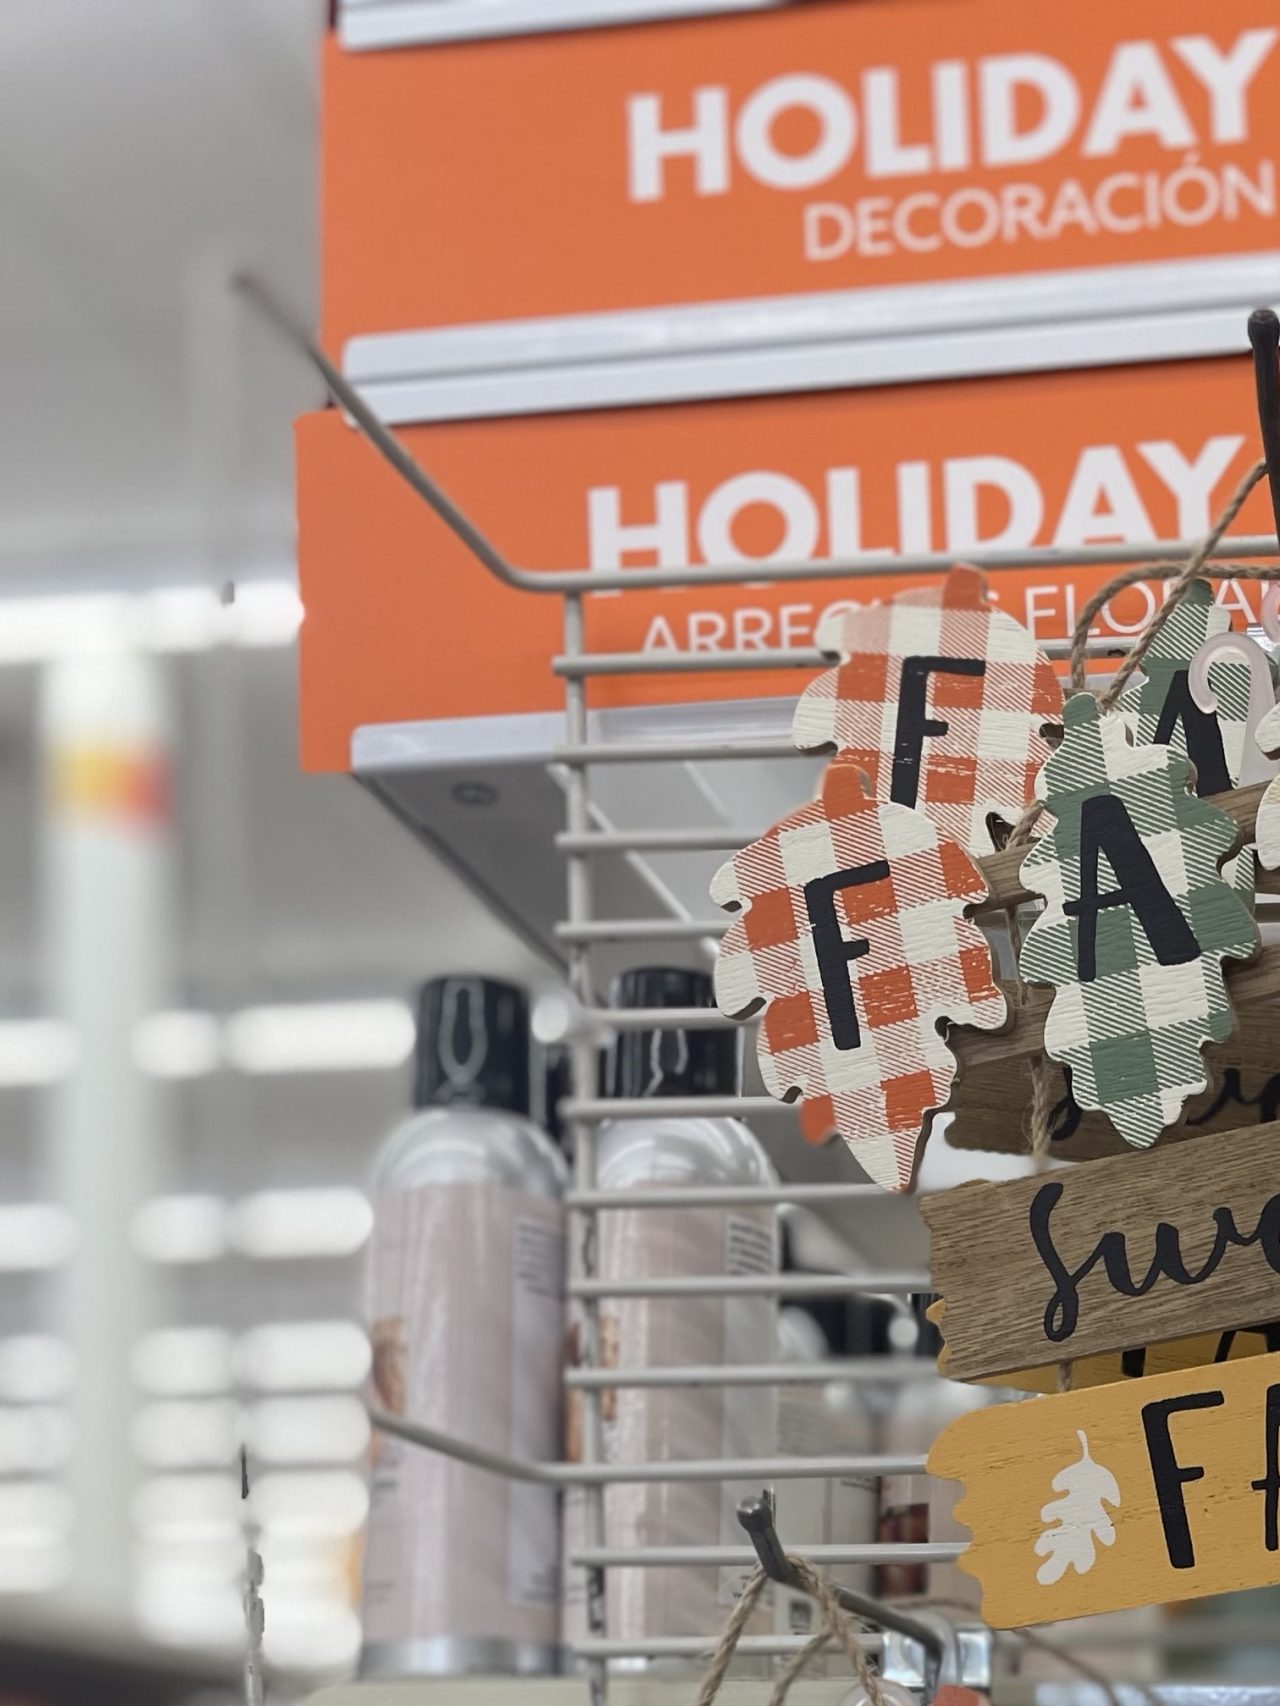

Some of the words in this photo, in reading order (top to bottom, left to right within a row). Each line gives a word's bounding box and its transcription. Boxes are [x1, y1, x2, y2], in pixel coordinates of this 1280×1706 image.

[626, 28, 1280, 200] HOLIDAY
[803, 150, 1278, 262] DECORACIÓN
[587, 435, 1246, 597] HOLIDAY
